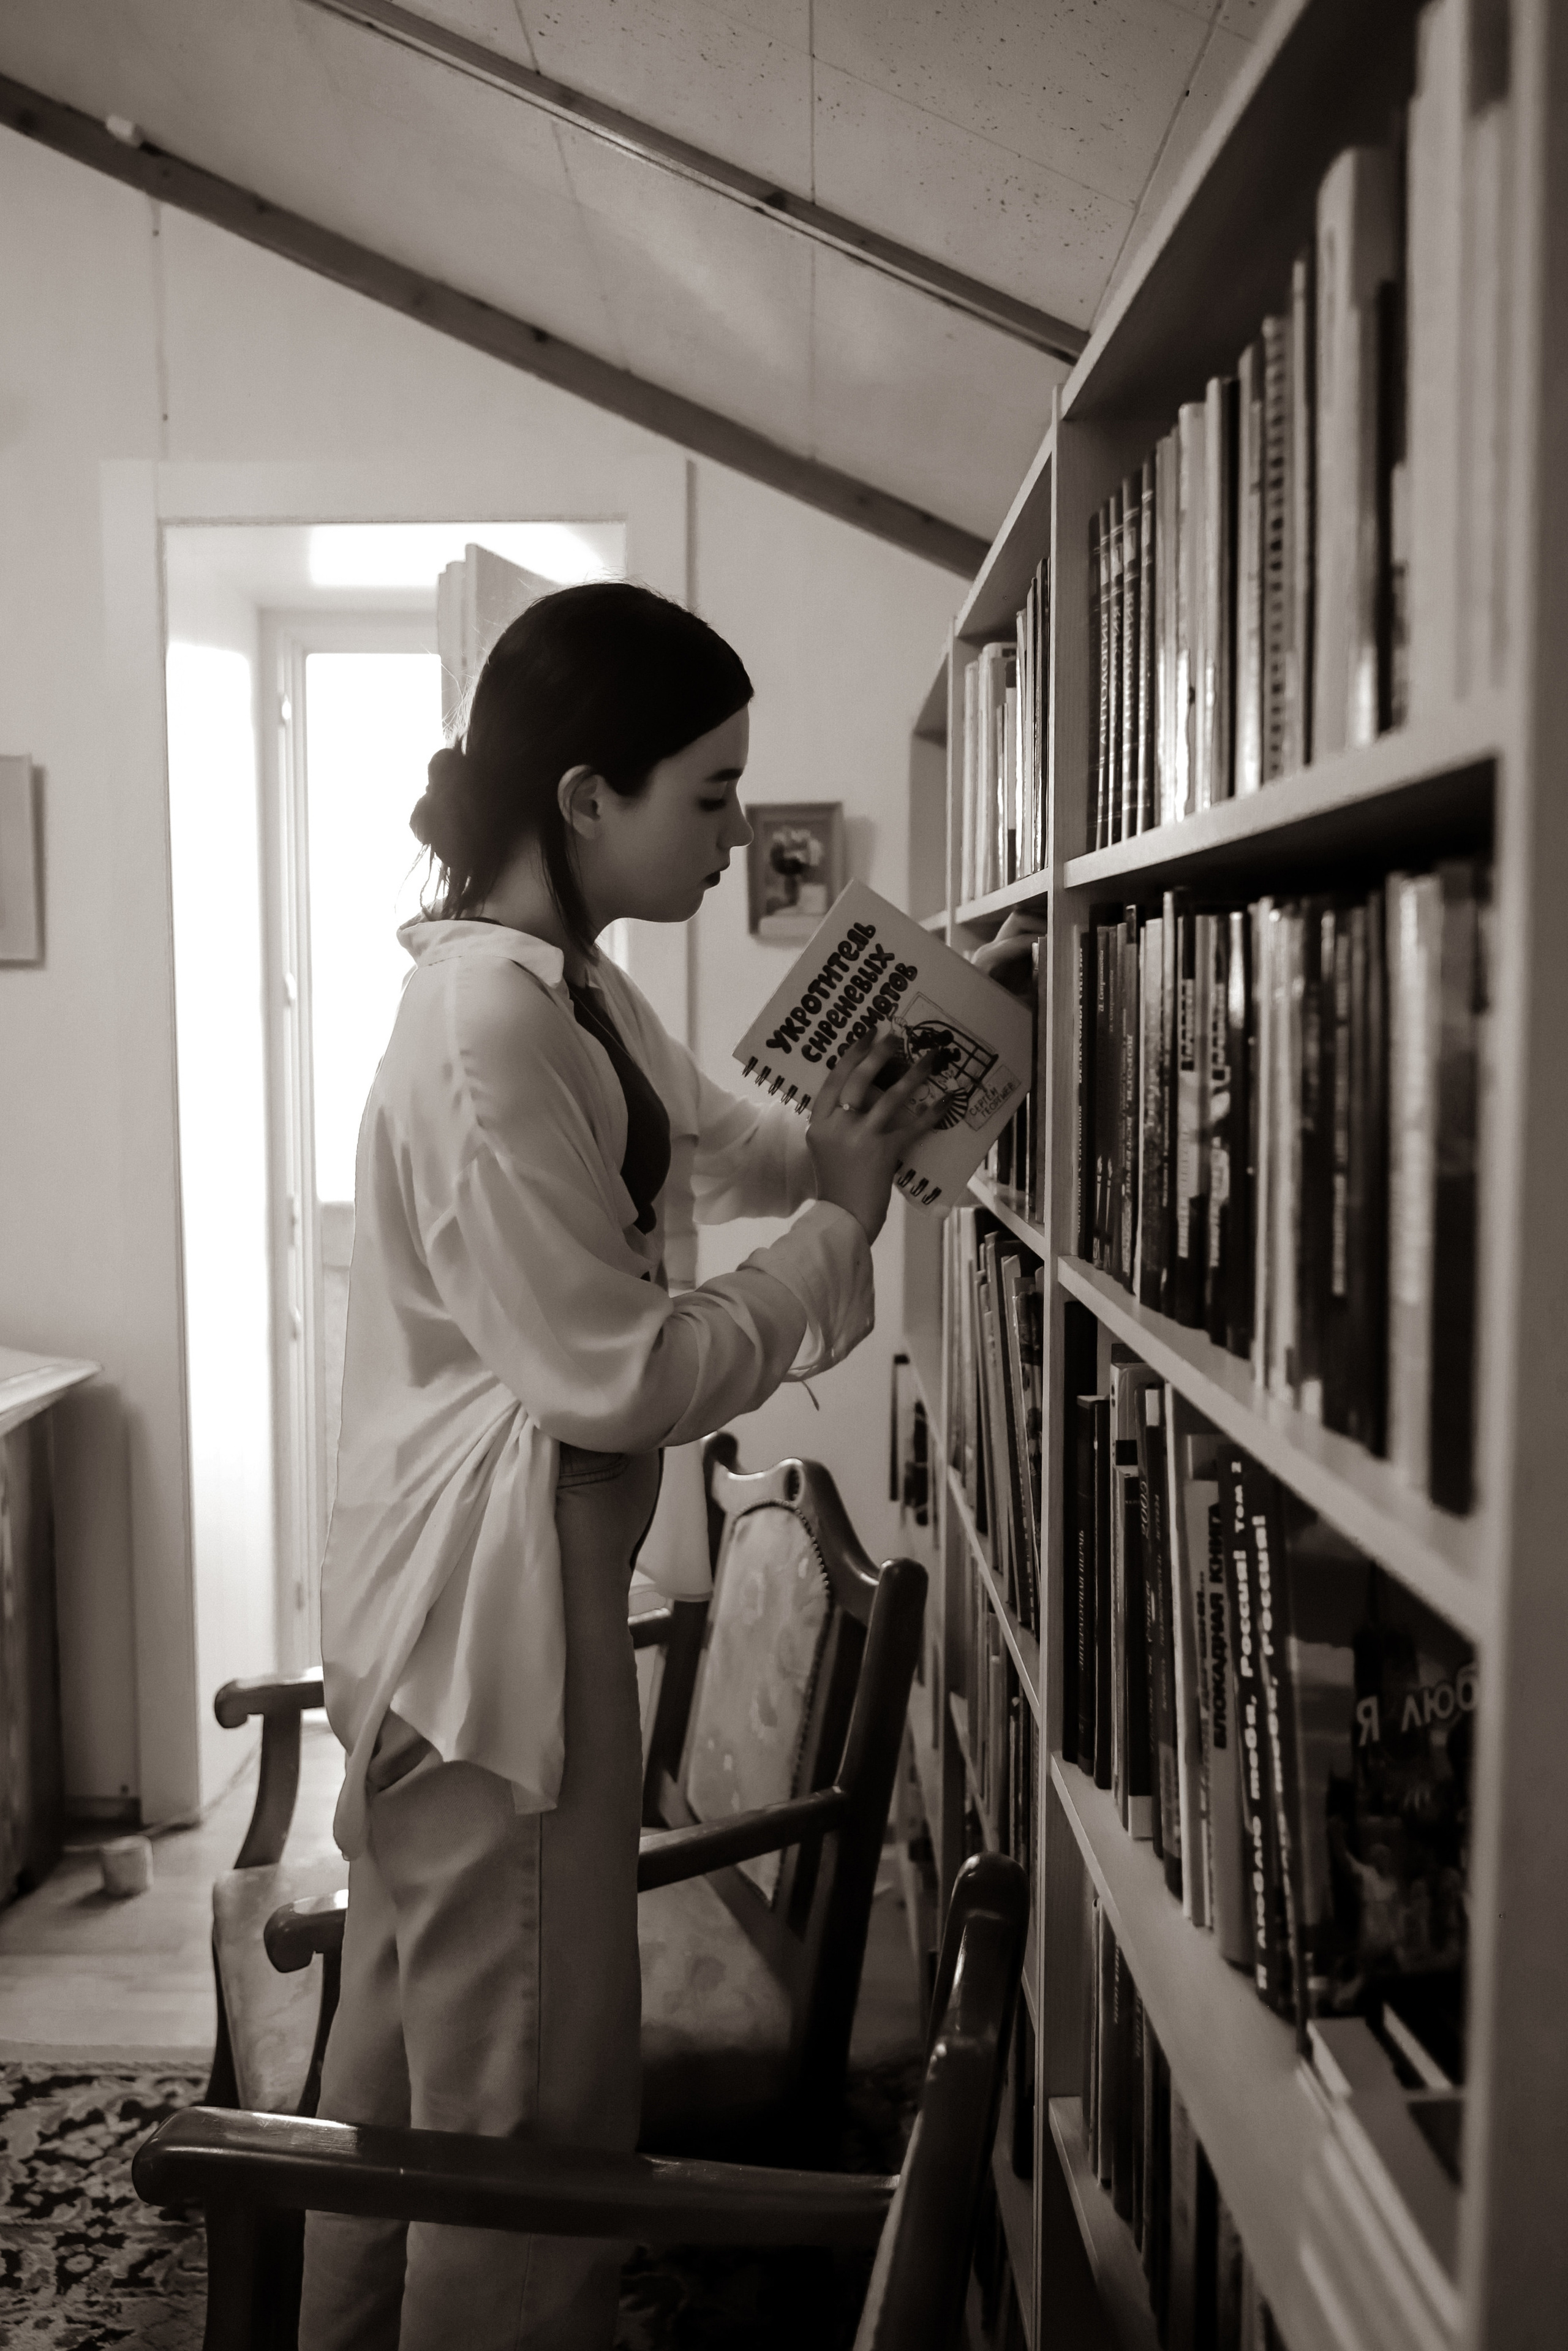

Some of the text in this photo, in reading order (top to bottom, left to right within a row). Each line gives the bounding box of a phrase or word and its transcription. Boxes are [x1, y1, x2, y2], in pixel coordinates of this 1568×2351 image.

[1208, 1503, 1227, 1749] БЛОКАДНАЯ КНИГА
[1233, 1550, 1253, 1677] Россия!
[1355, 1696, 1379, 1746] Я
[1253, 1816, 1266, 1949] люблю
